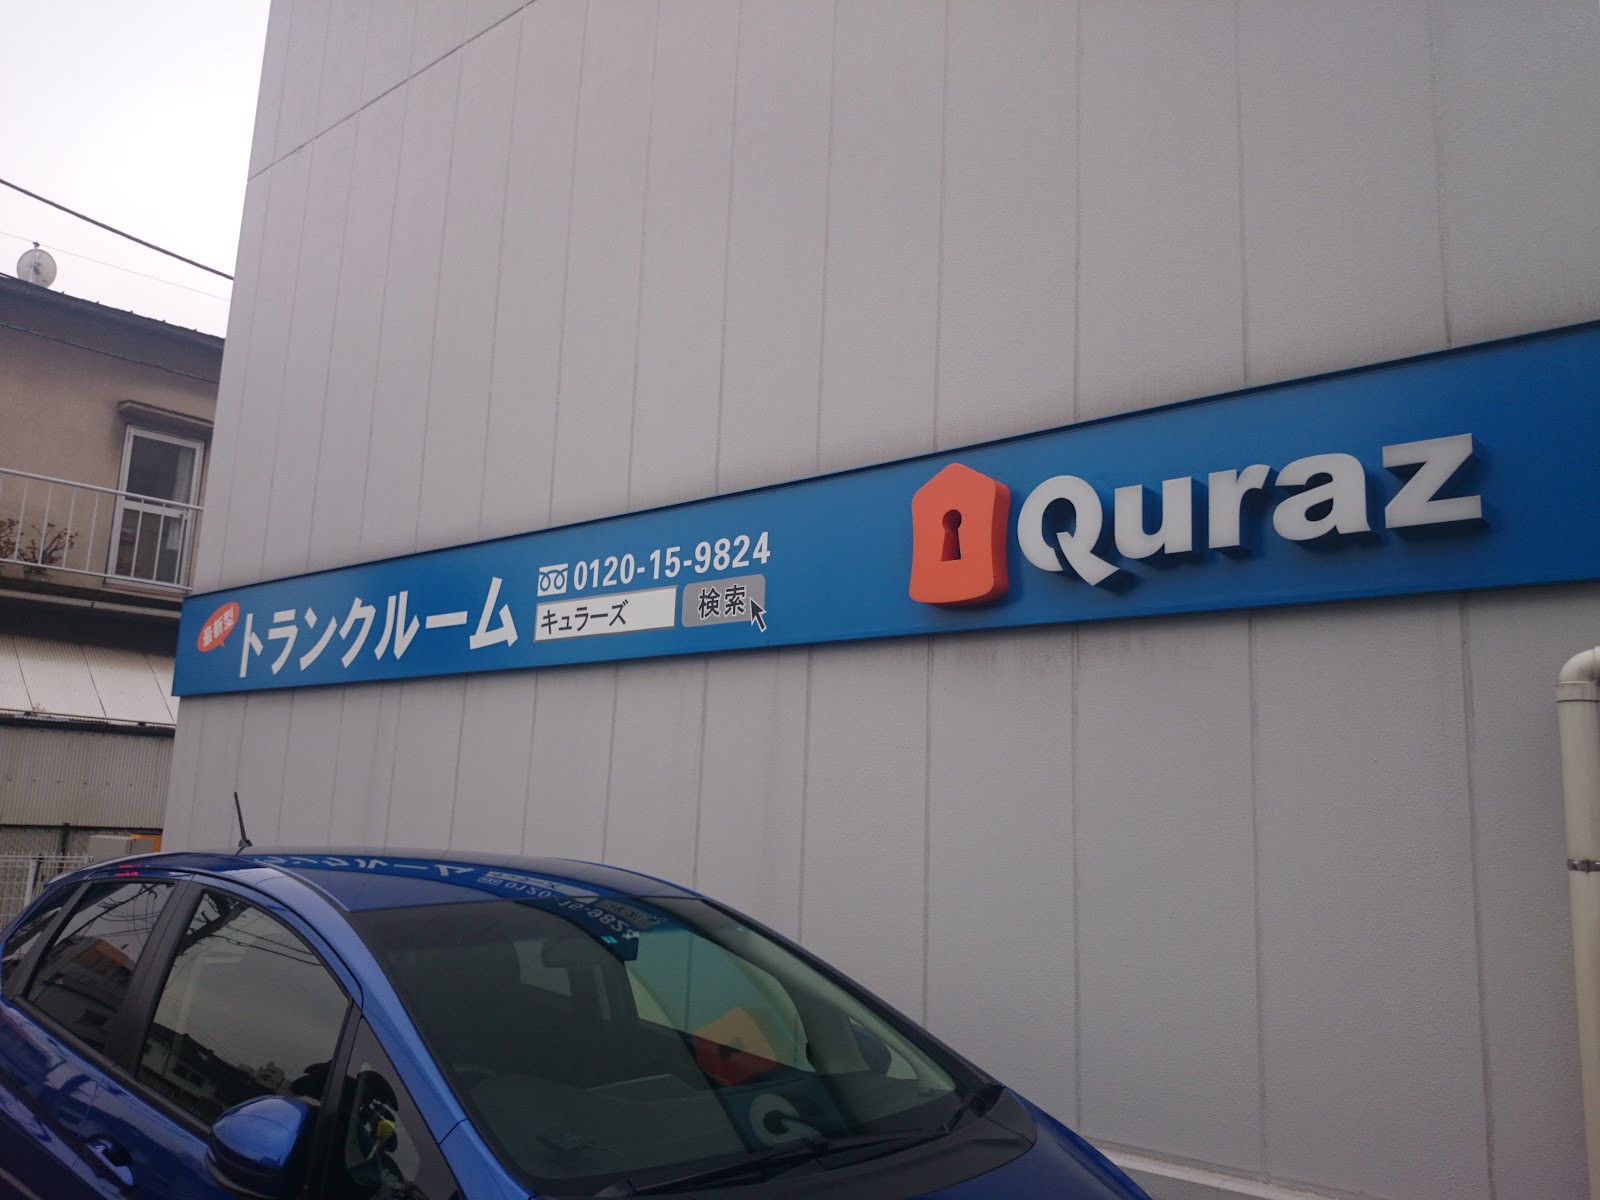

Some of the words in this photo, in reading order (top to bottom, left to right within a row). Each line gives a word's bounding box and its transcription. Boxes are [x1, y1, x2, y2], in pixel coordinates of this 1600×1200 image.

[1017, 433, 1483, 587] Quraz
[573, 531, 771, 592] 0120-15-9824
[239, 577, 519, 678] トランクルーム
[541, 599, 629, 635] キュラーズ
[698, 584, 746, 620] 検索
